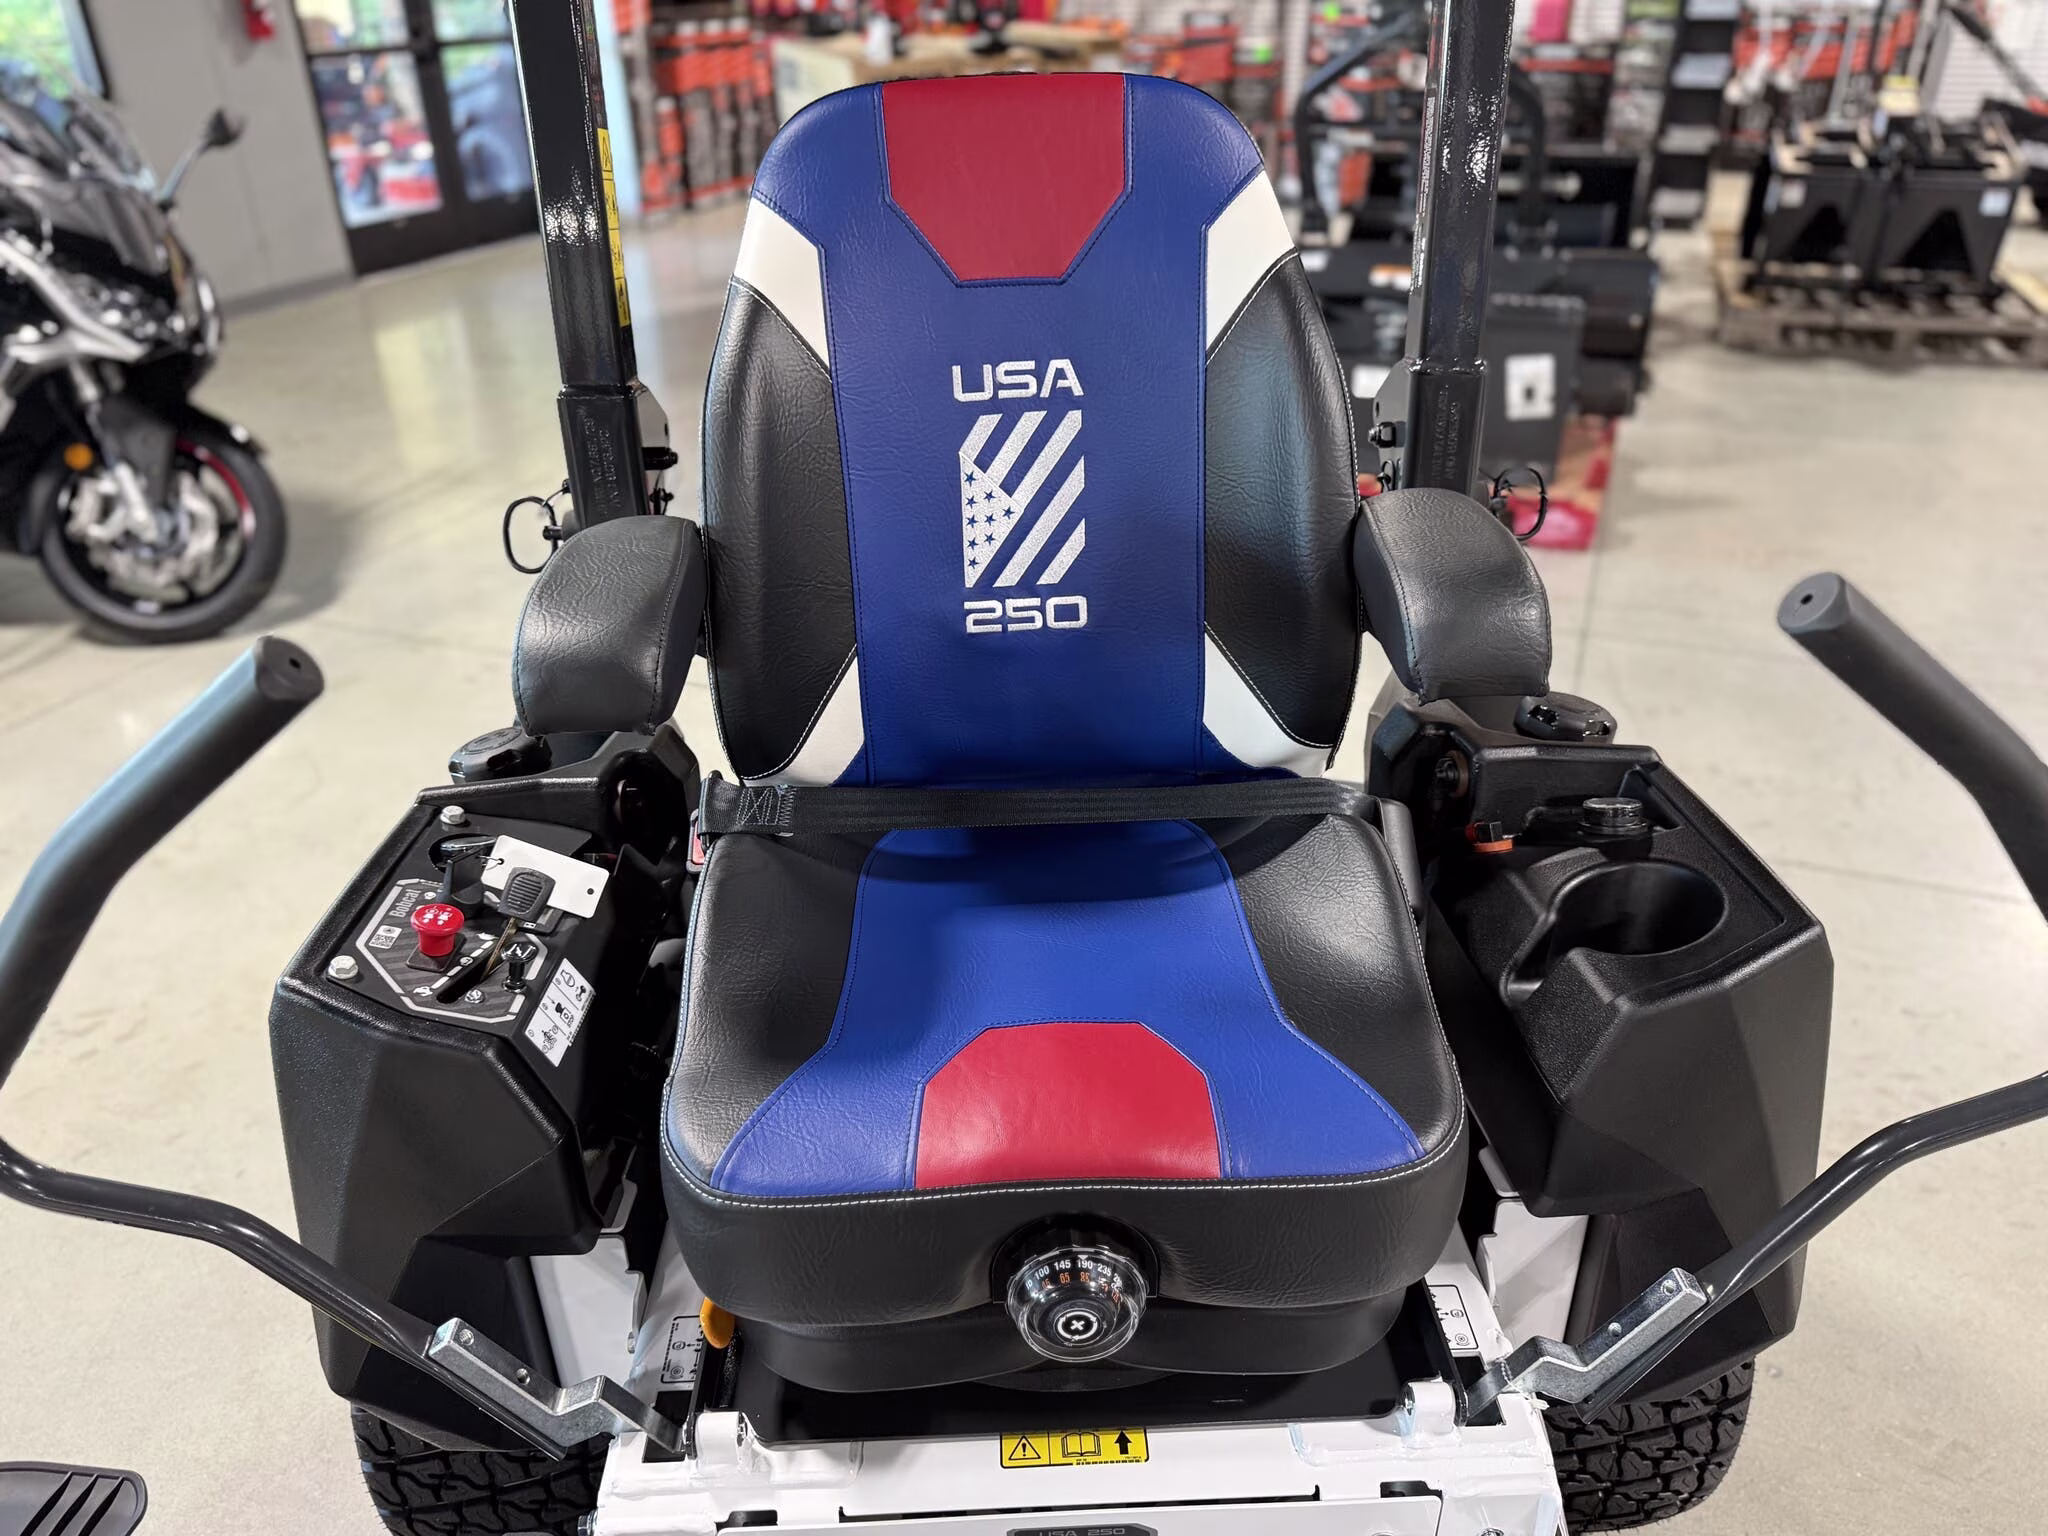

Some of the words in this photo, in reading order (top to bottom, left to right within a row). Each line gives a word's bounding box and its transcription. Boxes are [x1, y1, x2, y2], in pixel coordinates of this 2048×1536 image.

[952, 359, 1084, 402] USA
[964, 595, 1087, 633] 250
[388, 889, 421, 918] Bobcat
[1034, 1265, 1050, 1280] 100
[1054, 1259, 1072, 1271] 145
[1077, 1260, 1093, 1270] 190
[1097, 1263, 1112, 1277] 235
[1059, 1271, 1070, 1284] 65
[1088, 1527, 1126, 1536] 250
